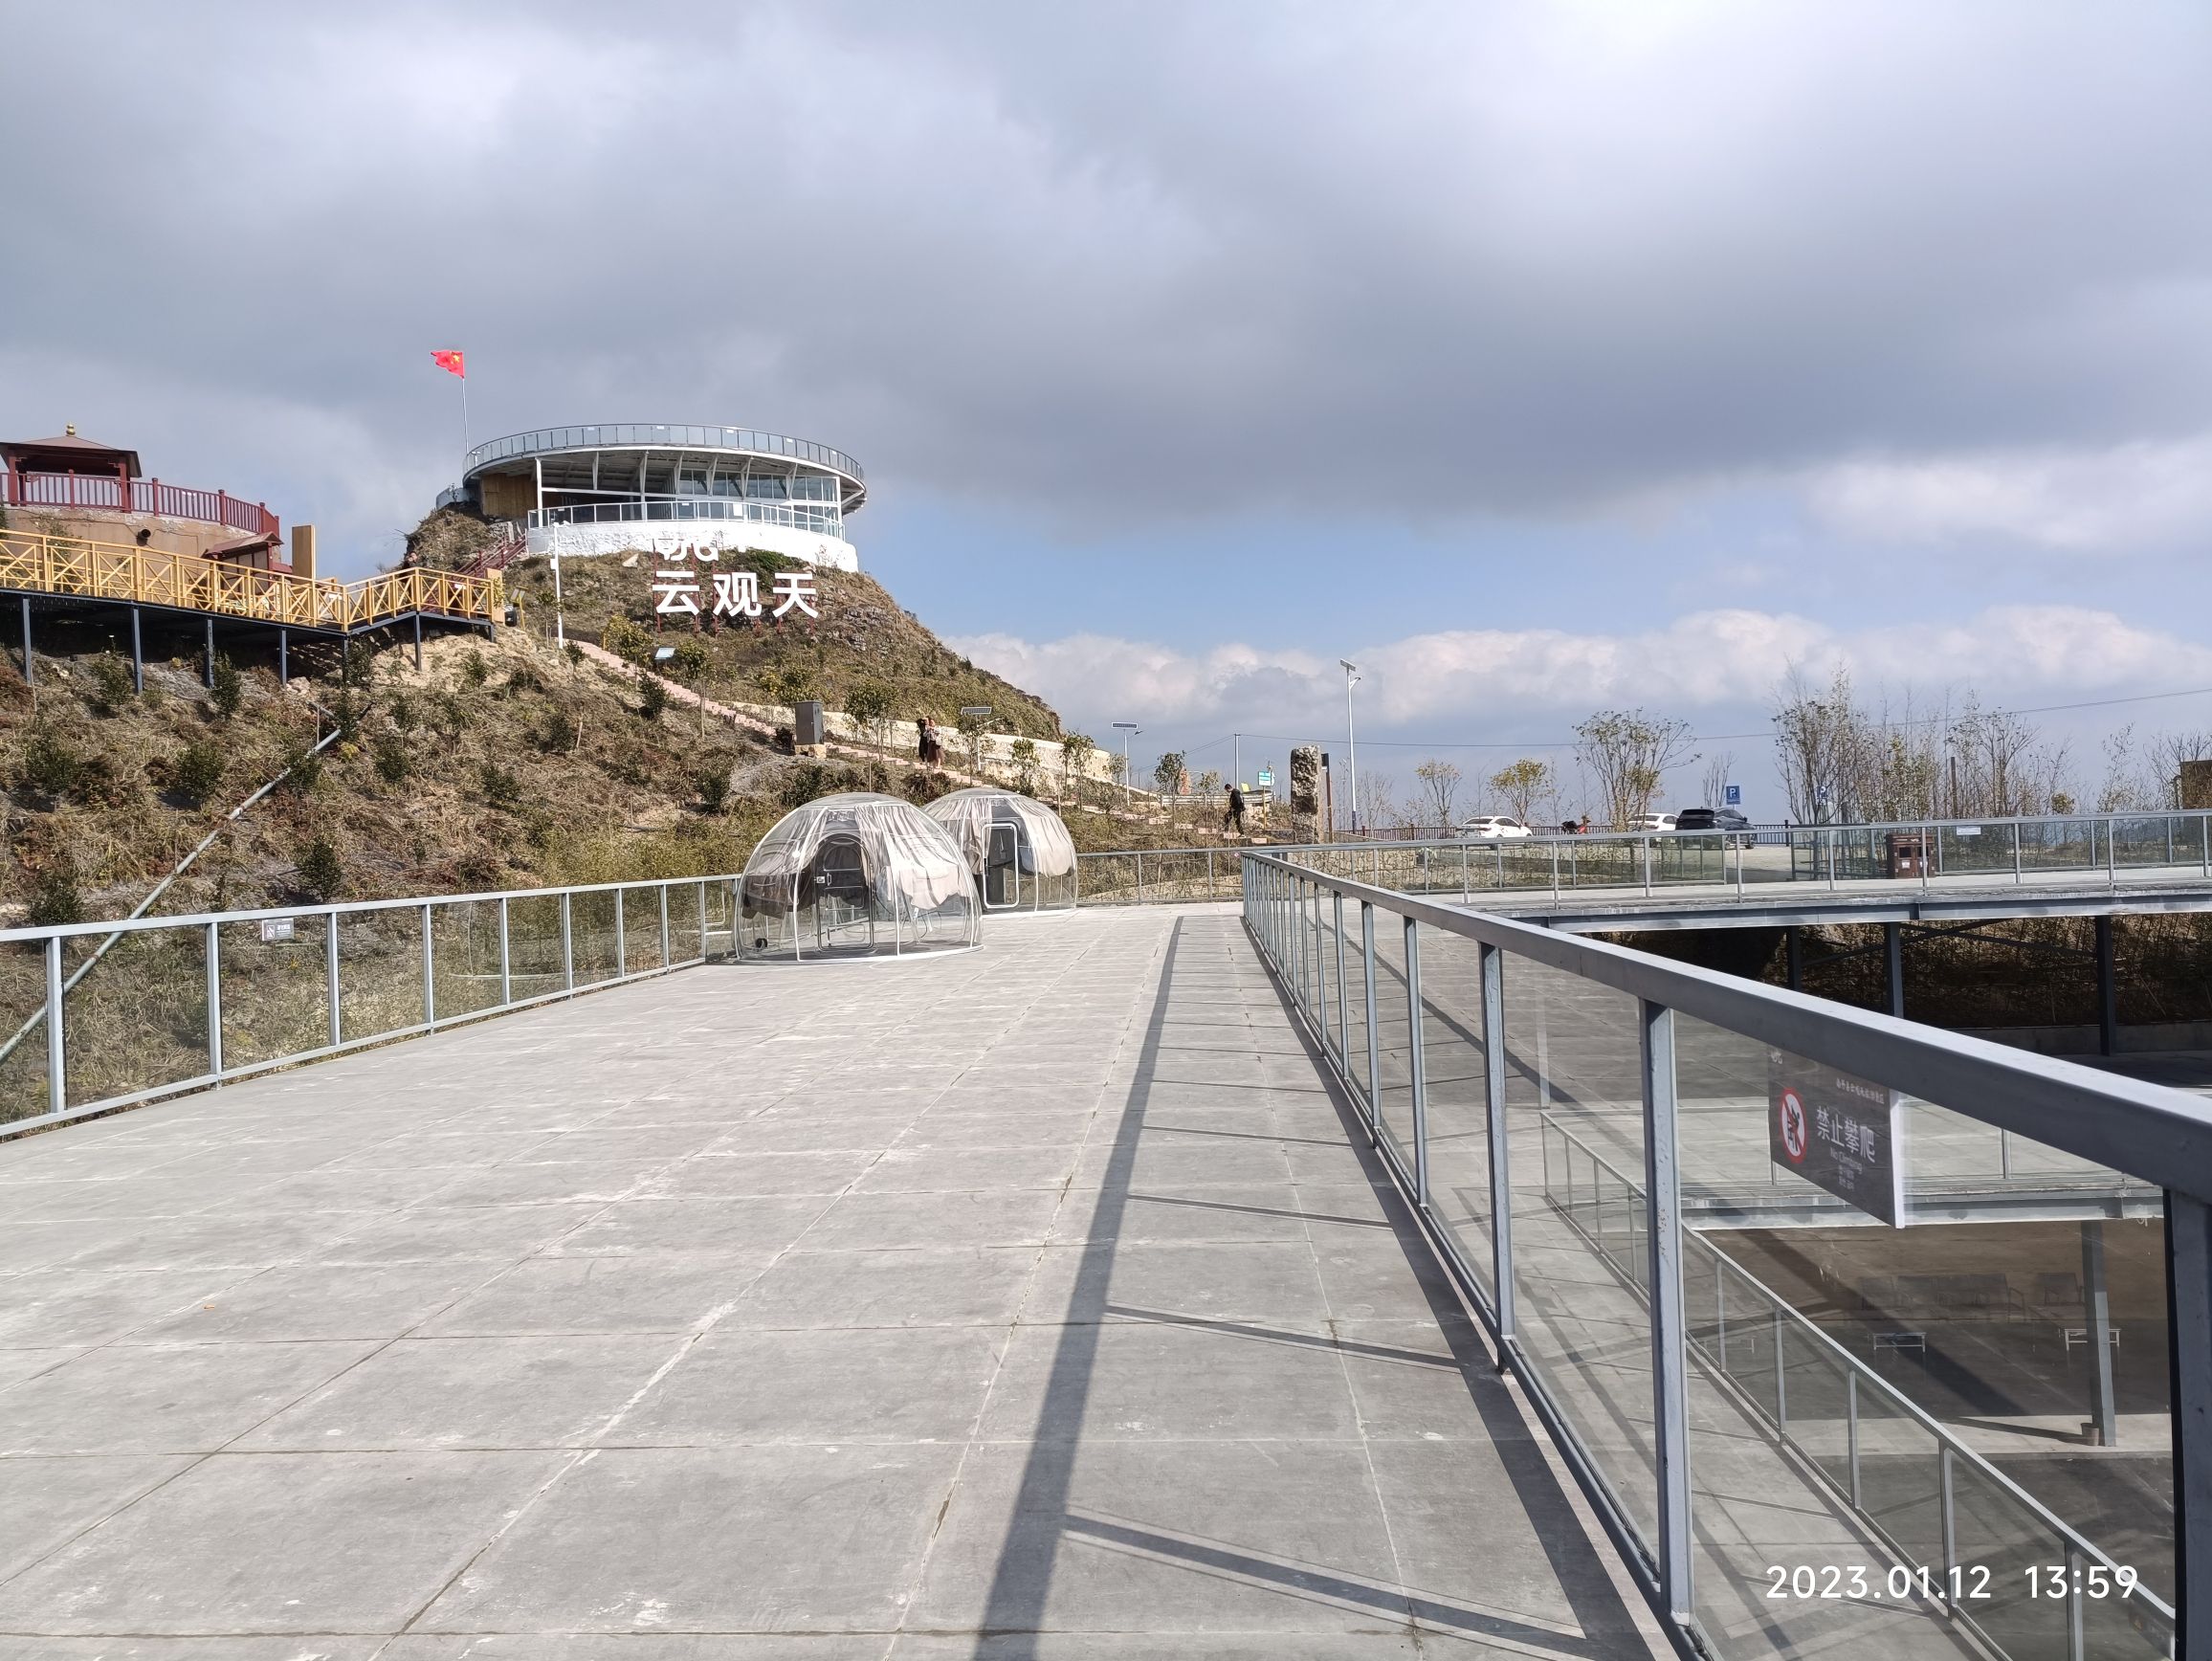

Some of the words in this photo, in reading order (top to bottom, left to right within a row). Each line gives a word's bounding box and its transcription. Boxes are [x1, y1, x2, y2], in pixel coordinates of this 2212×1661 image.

[653, 571, 818, 618] 云观天
[1817, 1105, 1875, 1163] 禁止攀爬
